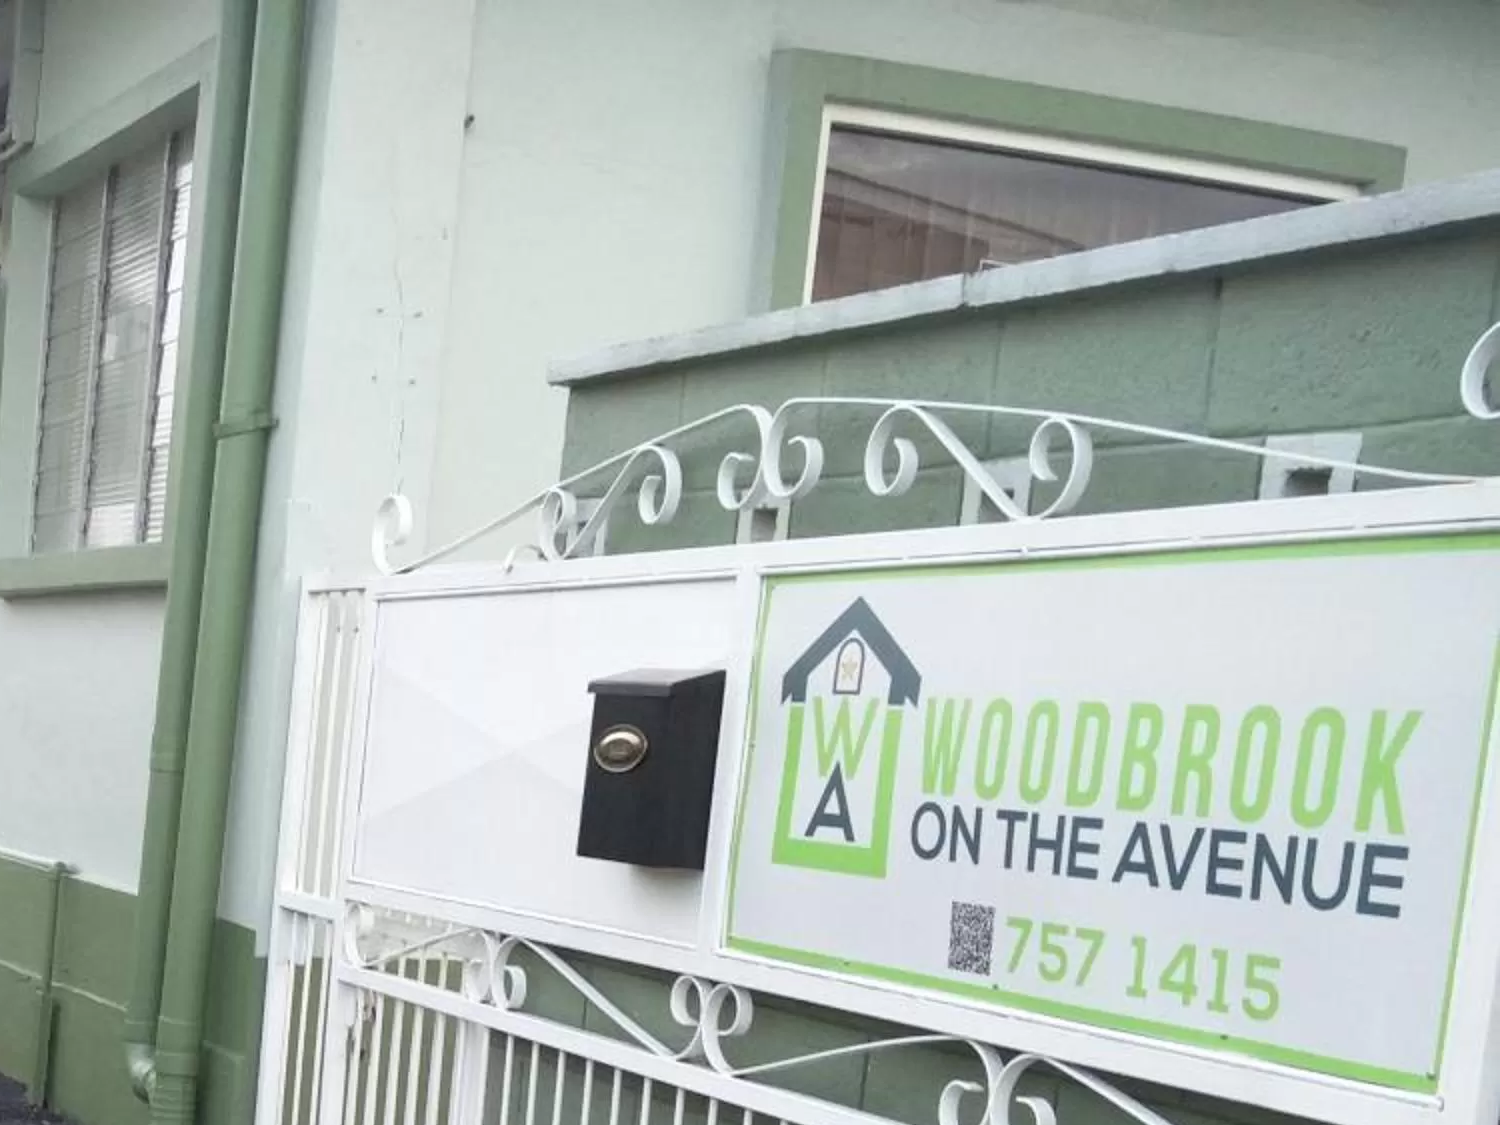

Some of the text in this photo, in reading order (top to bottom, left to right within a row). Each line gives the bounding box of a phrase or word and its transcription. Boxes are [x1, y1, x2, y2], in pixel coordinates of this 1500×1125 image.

[921, 698, 1422, 836] WOODBROOK
[910, 801, 1410, 919] ON THE AVENUE
[1004, 918, 1281, 1021] 757 1415
